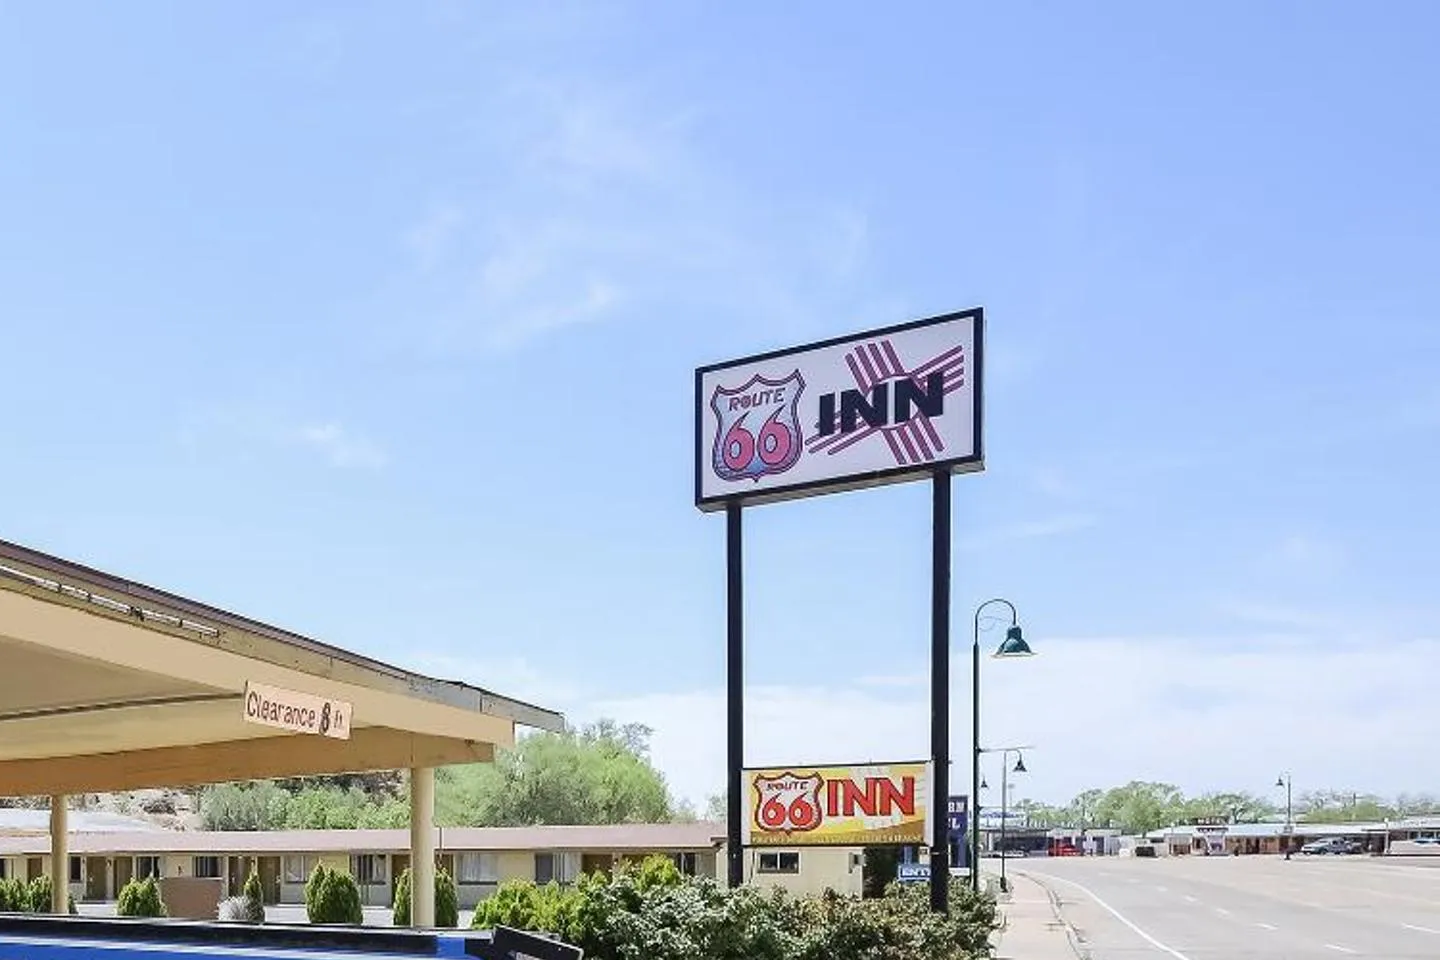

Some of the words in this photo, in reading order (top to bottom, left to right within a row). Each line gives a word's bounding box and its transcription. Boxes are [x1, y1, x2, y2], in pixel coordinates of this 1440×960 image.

[723, 405, 792, 471] 66
[819, 371, 944, 438] INN
[728, 387, 787, 412] ROUTE
[247, 690, 316, 728] Clearance
[321, 702, 331, 733] 8
[762, 792, 813, 826] 66
[826, 776, 915, 817] INN
[766, 781, 809, 791] ROUTE
